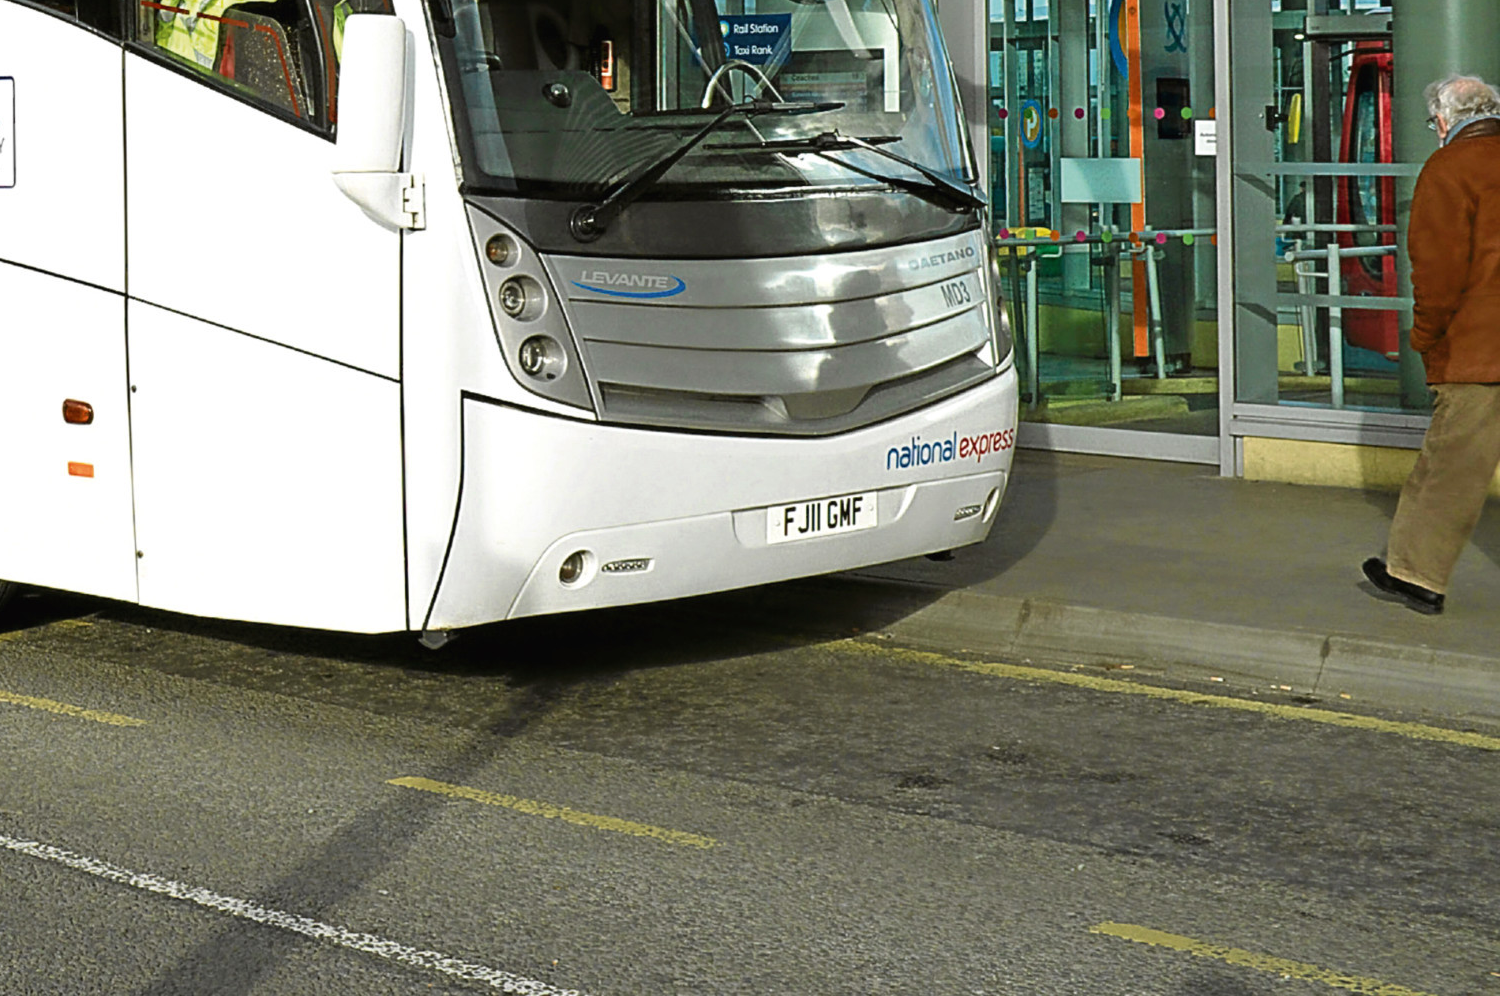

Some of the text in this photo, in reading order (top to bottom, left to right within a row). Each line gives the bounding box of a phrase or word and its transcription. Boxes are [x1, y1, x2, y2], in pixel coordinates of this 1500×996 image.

[733, 22, 779, 34] Rail Station
[734, 44, 773, 55] Taxi Rank
[909, 246, 975, 271] CAETANO
[580, 270, 669, 290] LEVANTE
[940, 280, 971, 308] MD3
[886, 427, 1015, 471] national express
[784, 495, 864, 536] FJ11 GMF
